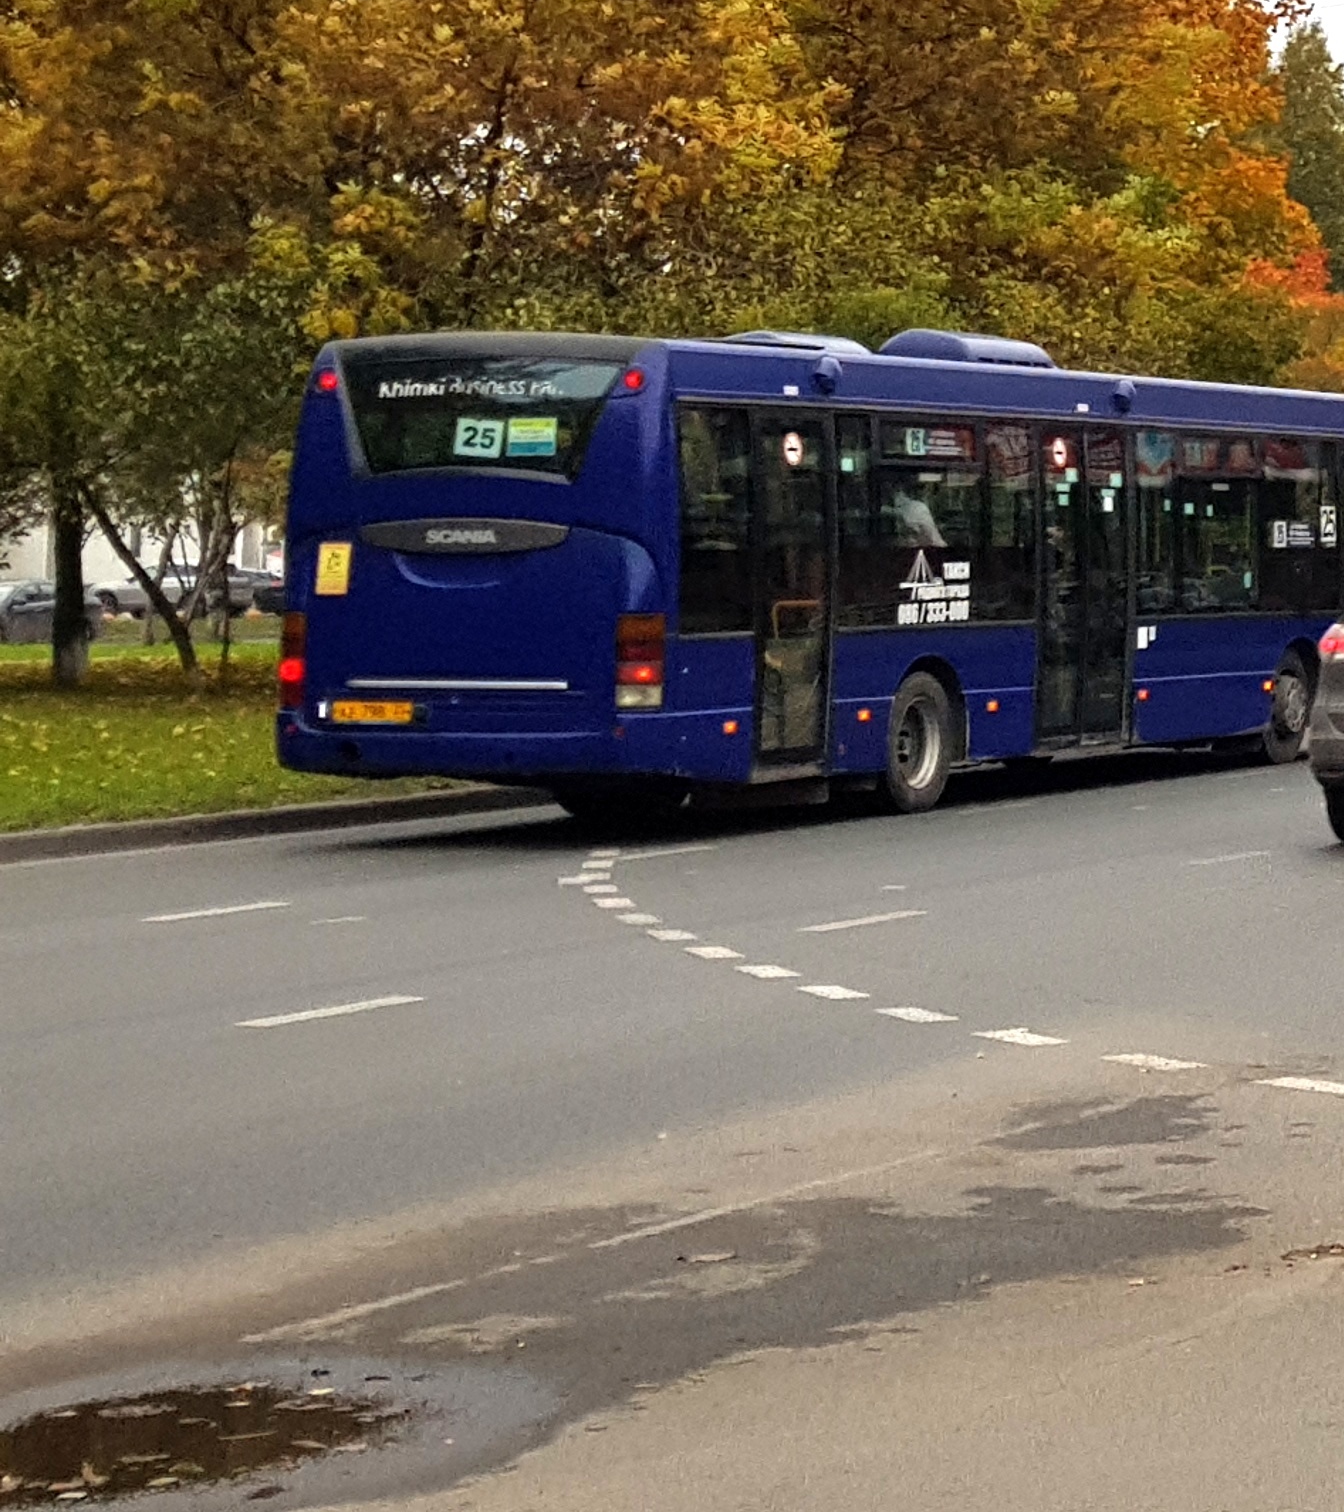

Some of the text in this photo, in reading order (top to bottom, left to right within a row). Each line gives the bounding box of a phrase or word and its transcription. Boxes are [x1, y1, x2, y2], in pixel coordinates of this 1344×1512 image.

[462, 426, 496, 449] 25
[1322, 509, 1335, 538] 25
[425, 529, 497, 544] SCANIA
